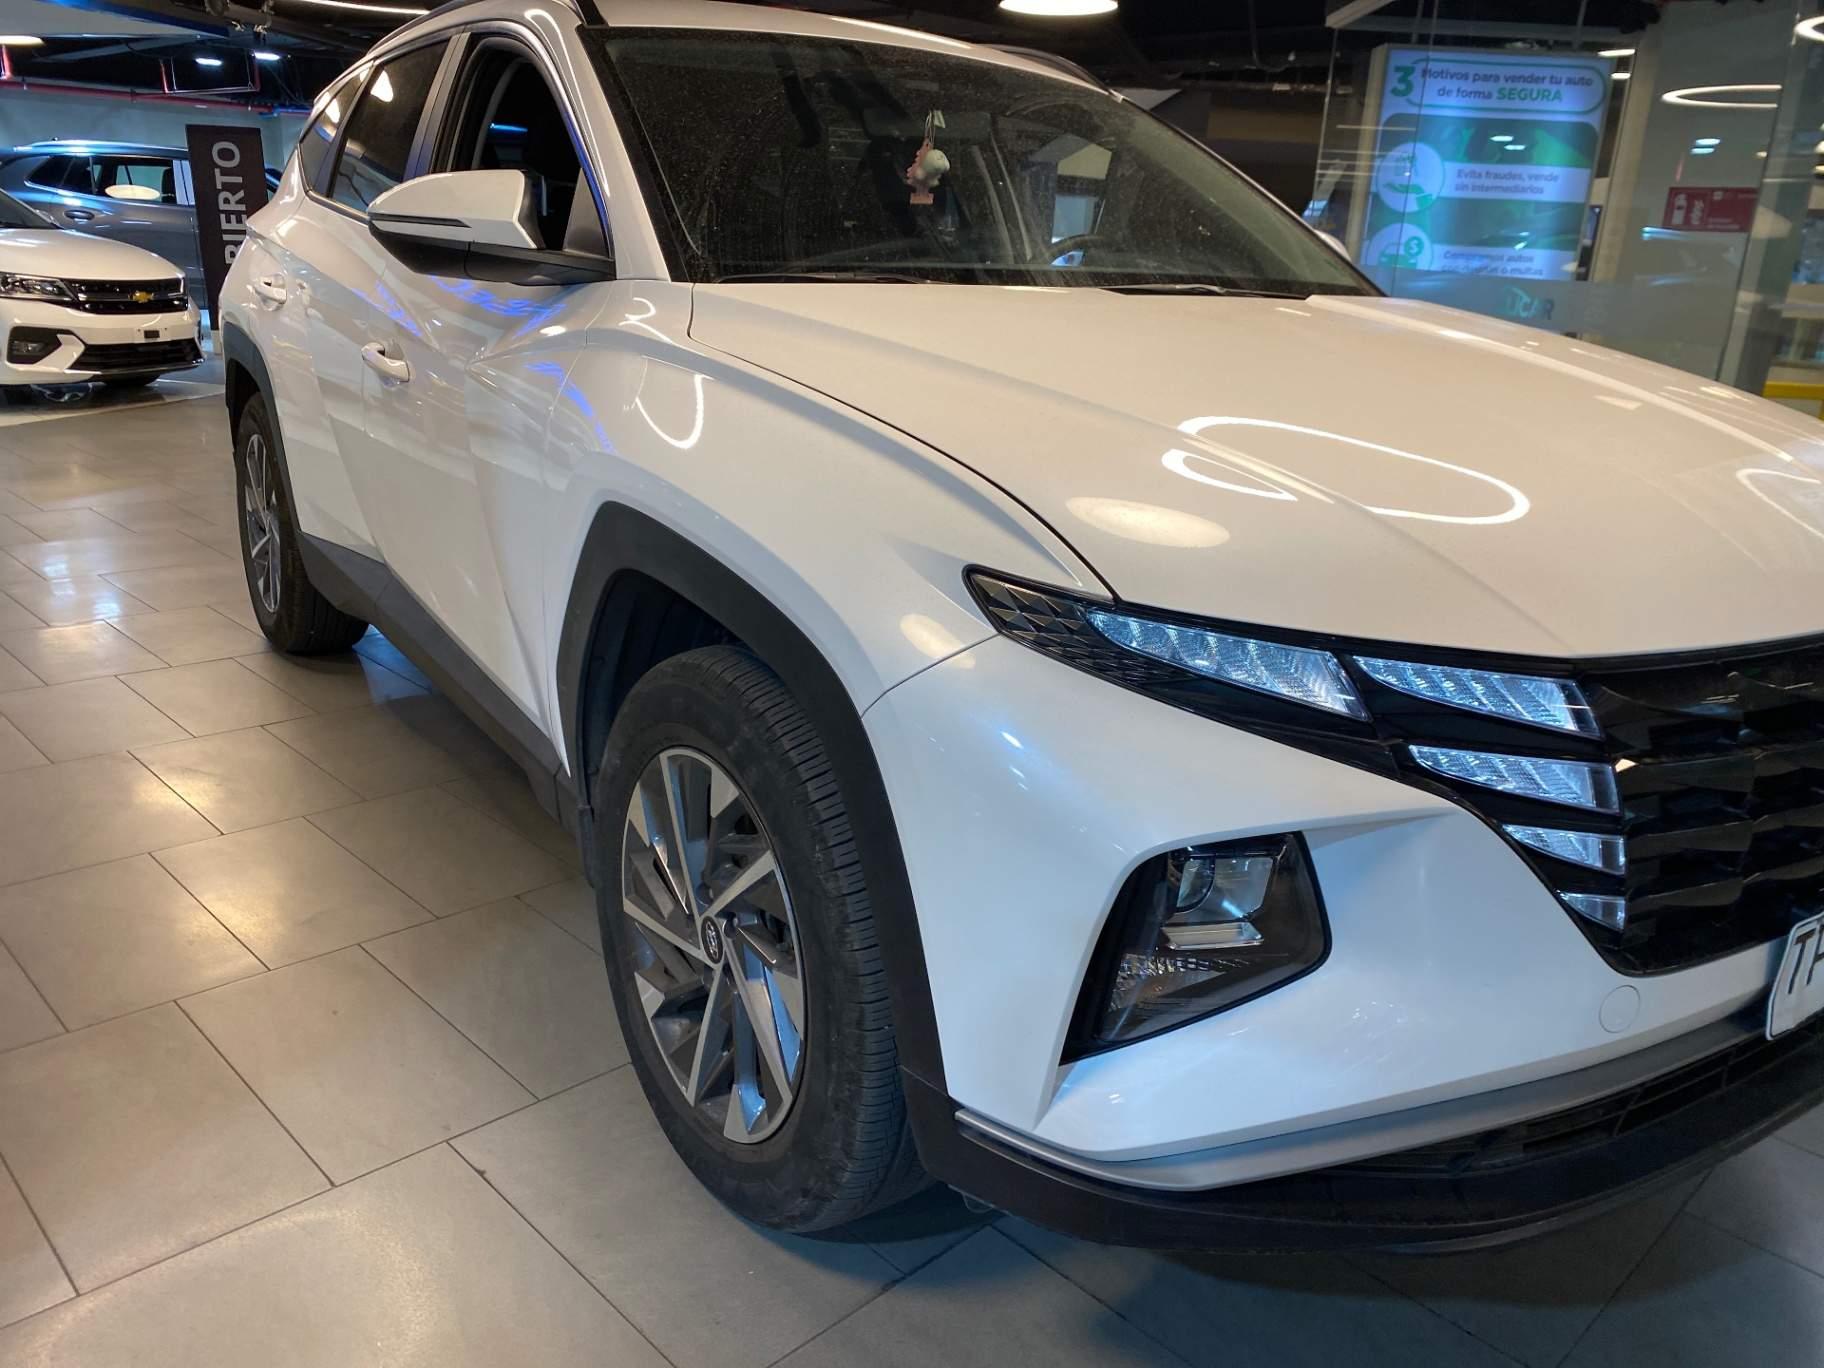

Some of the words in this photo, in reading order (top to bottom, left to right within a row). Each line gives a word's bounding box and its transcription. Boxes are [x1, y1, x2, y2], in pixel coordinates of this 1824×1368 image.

[1391, 66, 1416, 97] 3
[1421, 68, 1469, 81] Motivos
[1472, 73, 1500, 85] para
[1504, 73, 1547, 85] vender
[1549, 75, 1563, 85] tu
[1565, 75, 1593, 86] auto
[1437, 84, 1453, 96] de
[1455, 86, 1493, 99] forma
[1497, 87, 1563, 102] SEGURA
